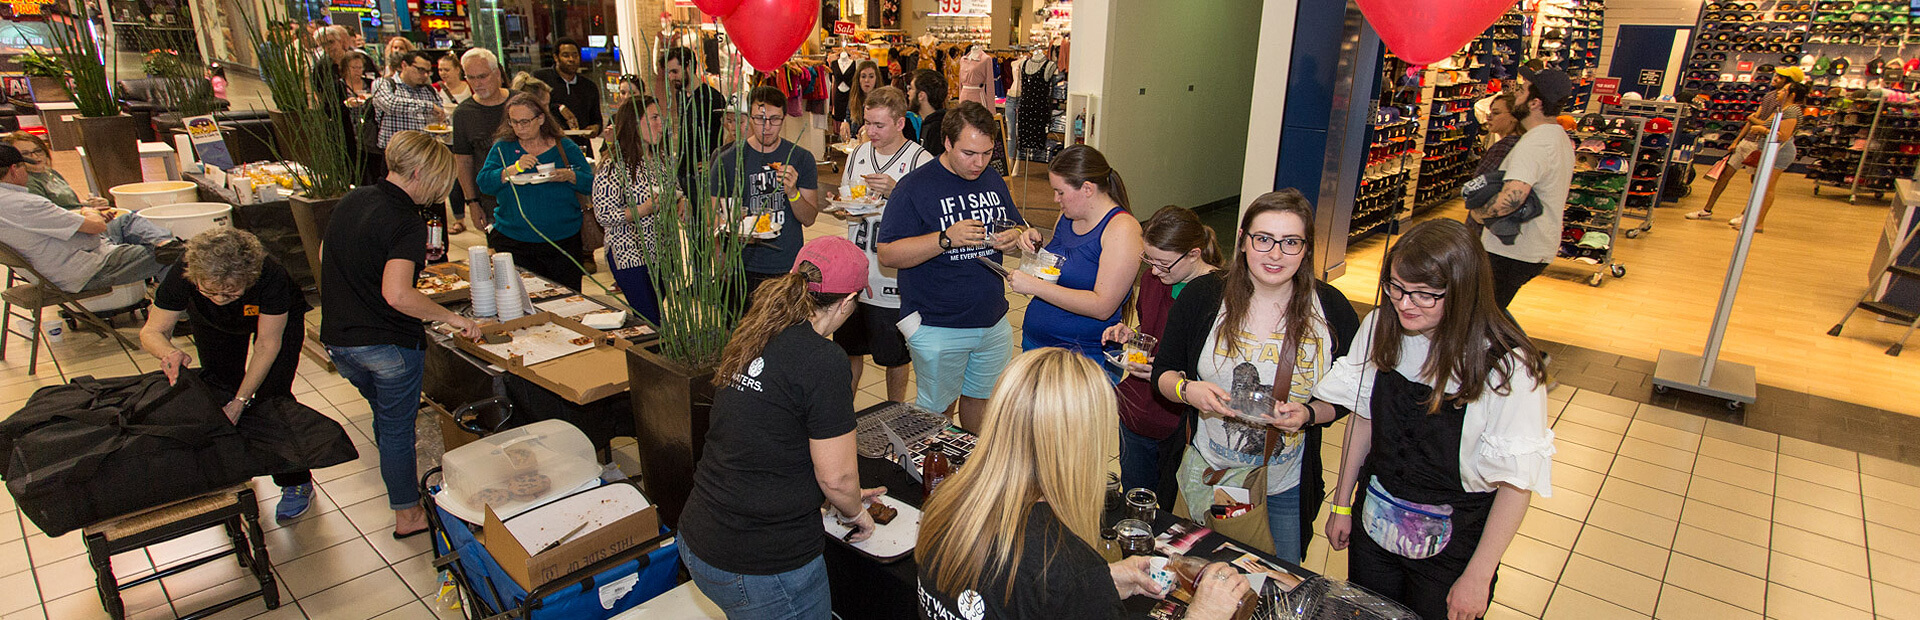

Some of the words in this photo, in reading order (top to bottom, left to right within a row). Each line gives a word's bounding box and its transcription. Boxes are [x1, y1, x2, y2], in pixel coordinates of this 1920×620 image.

[835, 23, 854, 34] Sale
[749, 171, 784, 194] HOM
[940, 197, 956, 214] IF
[958, 195, 966, 211] I
[967, 191, 1000, 208] SAID
[940, 212, 963, 232] I'L
[960, 252, 978, 260] EVERY
[610, 536, 634, 555] THIS
[583, 548, 606, 565] SIDE
[567, 560, 580, 574] UP
